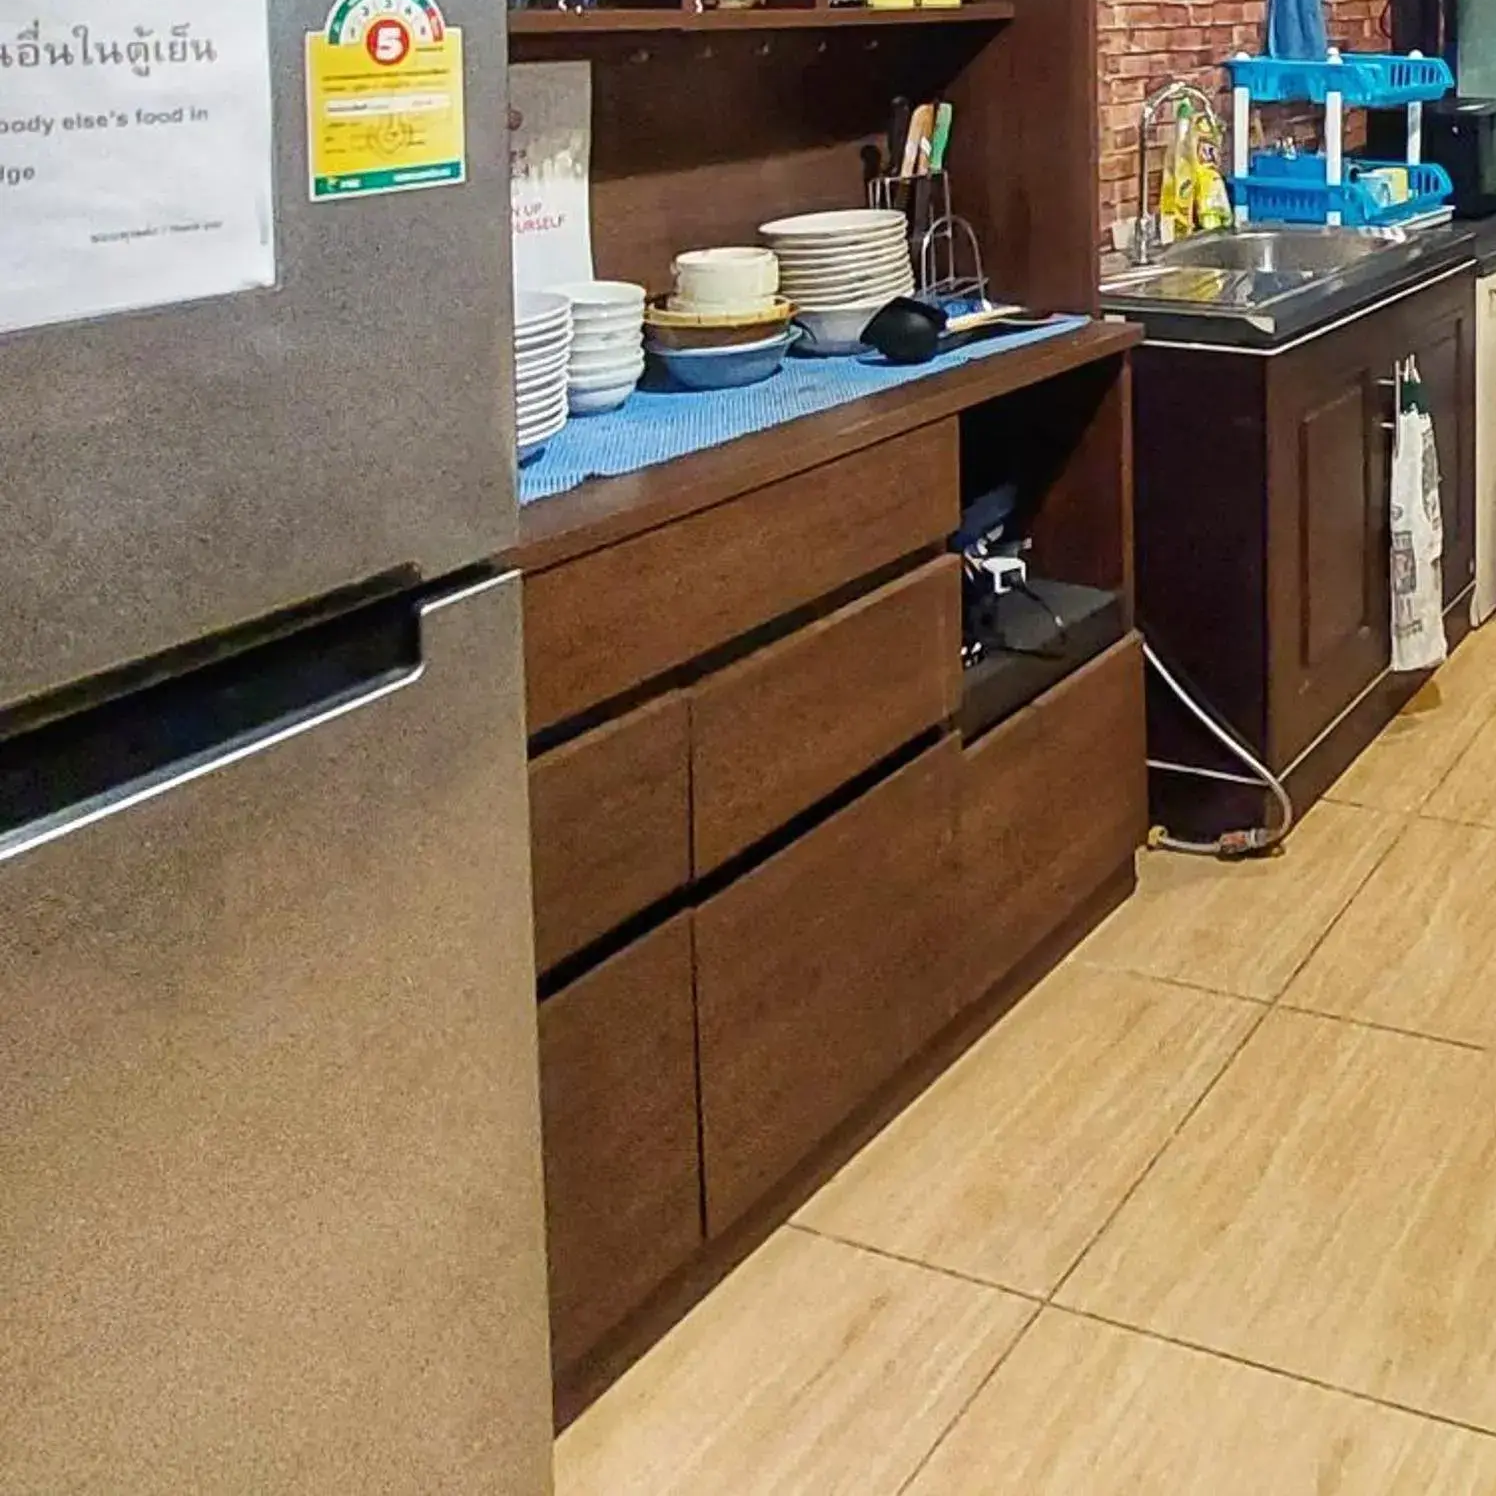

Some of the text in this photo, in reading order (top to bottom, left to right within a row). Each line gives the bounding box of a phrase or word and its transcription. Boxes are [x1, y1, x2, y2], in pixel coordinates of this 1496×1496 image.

[375, 26, 405, 62] 5
[62, 110, 129, 132] else's
[135, 107, 184, 127] food
[190, 105, 209, 123] in
